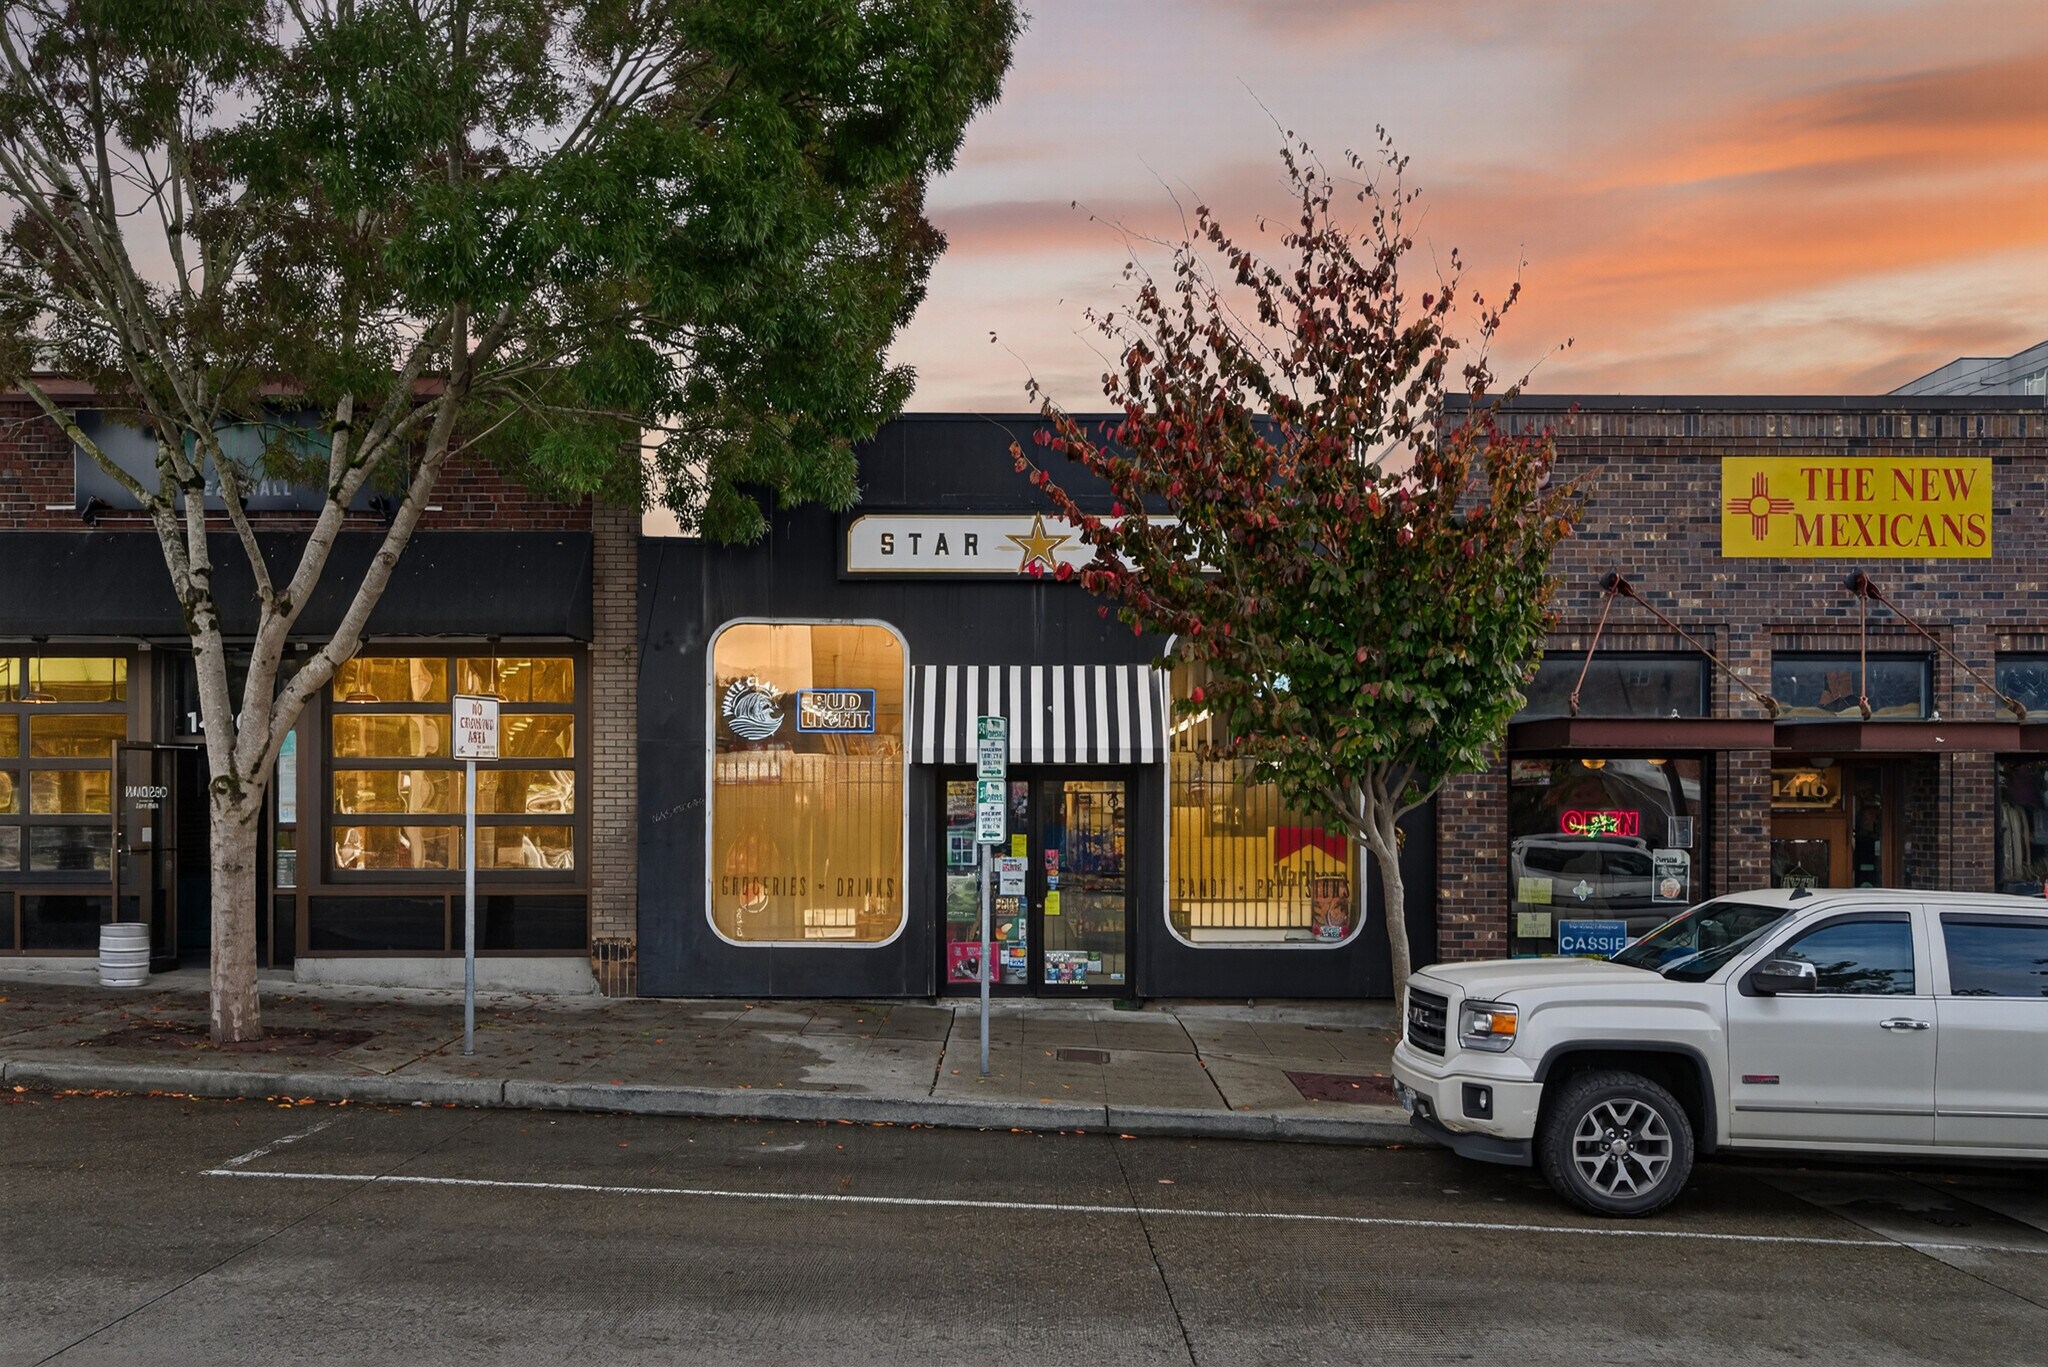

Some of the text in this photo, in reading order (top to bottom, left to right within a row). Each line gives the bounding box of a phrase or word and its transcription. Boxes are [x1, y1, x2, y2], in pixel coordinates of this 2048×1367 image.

[1801, 468, 1977, 502] THE NEW
[1793, 513, 1987, 548] MEXICANS
[881, 533, 979, 556] STAR
[1561, 810, 1639, 837] OPEN
[721, 875, 895, 899] GROCERIES DRINKS
[1178, 877, 1225, 898] CANDY
[1561, 936, 1624, 951] CASSIE
